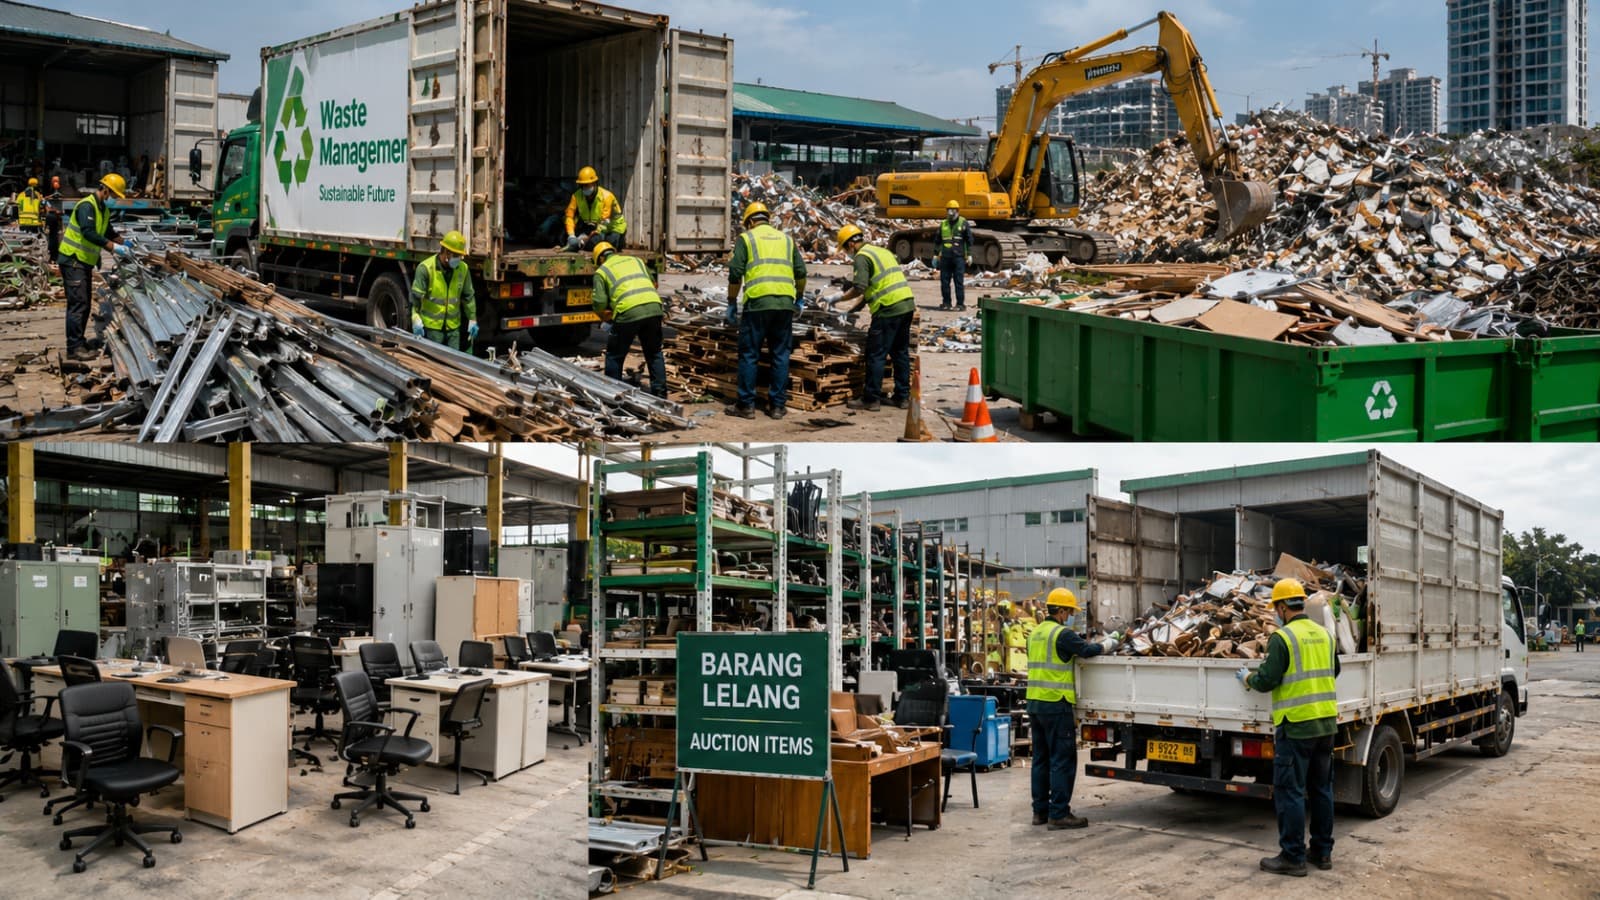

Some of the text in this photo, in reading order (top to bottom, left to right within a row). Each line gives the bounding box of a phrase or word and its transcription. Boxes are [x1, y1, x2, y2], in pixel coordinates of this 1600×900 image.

[320, 98, 367, 130] Waste
[319, 137, 408, 173] Managemen
[319, 184, 396, 203] Sustainable Future
[701, 652, 802, 677] BARANG
[703, 683, 800, 710] LELANG
[690, 732, 814, 756] AUCTION ITEMS
